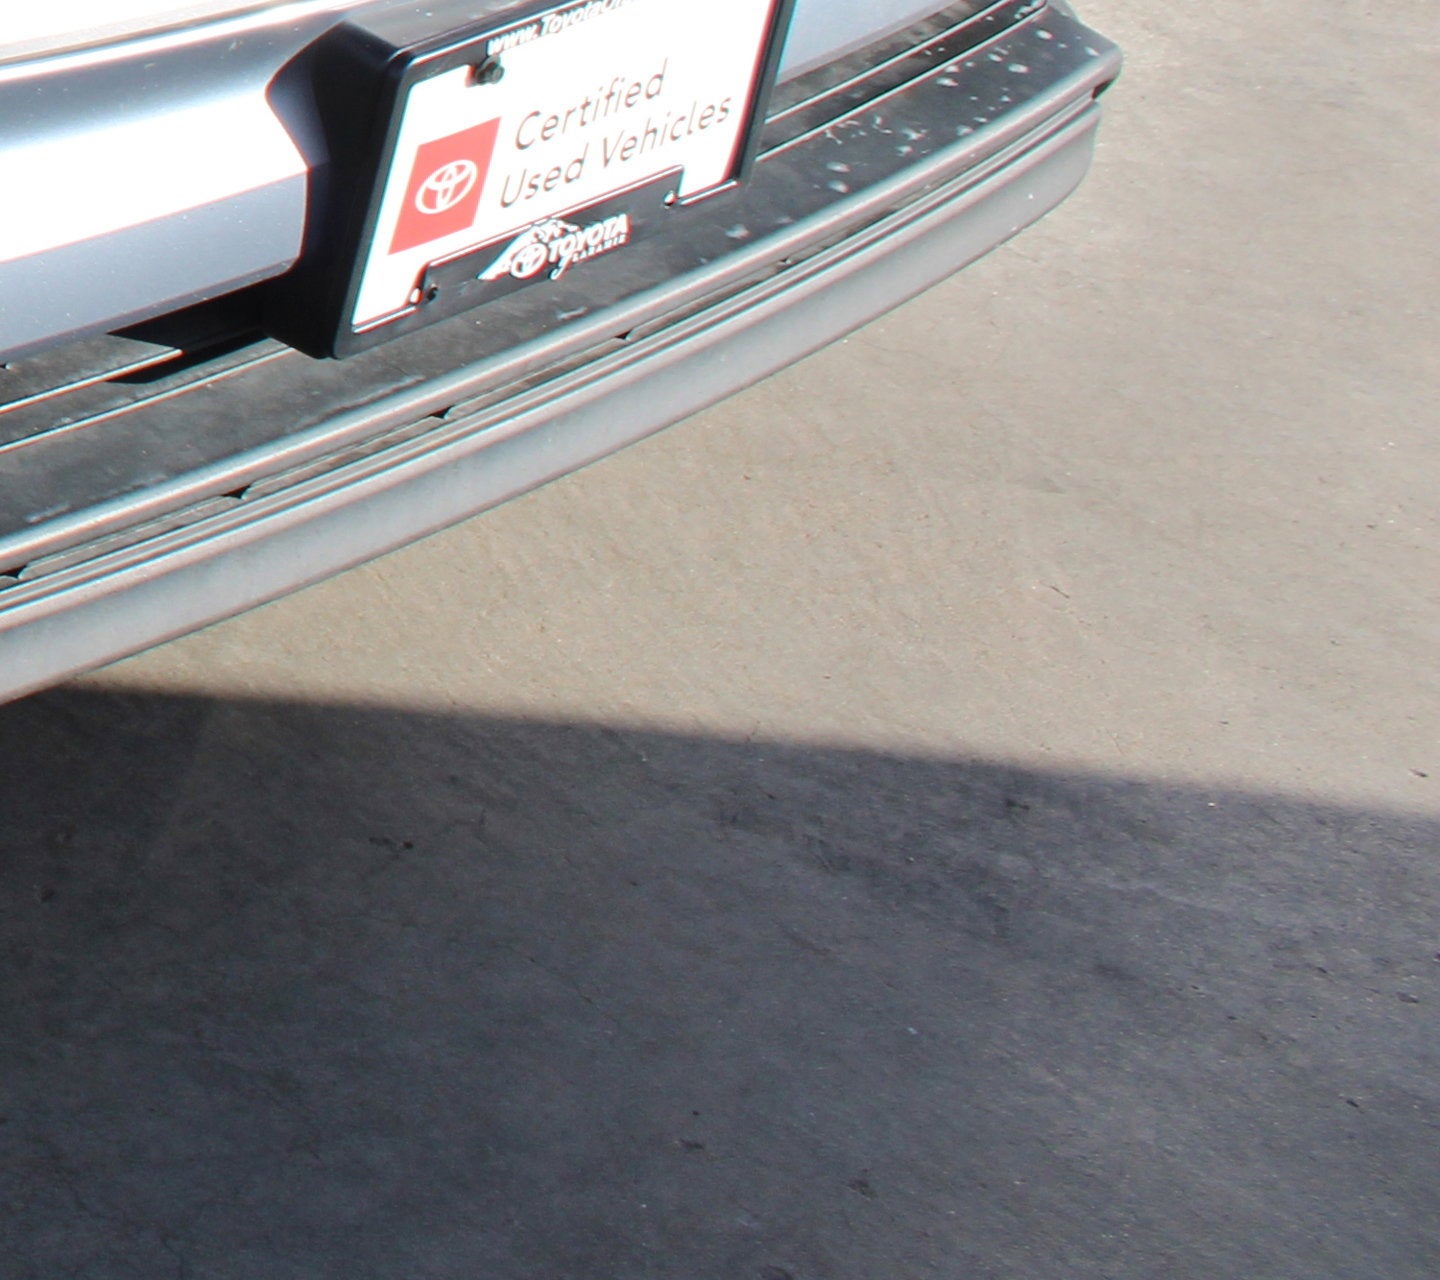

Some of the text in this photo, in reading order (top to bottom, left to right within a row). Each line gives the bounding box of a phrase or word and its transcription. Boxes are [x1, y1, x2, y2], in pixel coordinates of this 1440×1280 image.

[514, 56, 669, 151] Certified
[499, 96, 732, 209] Used Vehicles
[548, 212, 629, 263] TOYOTA
